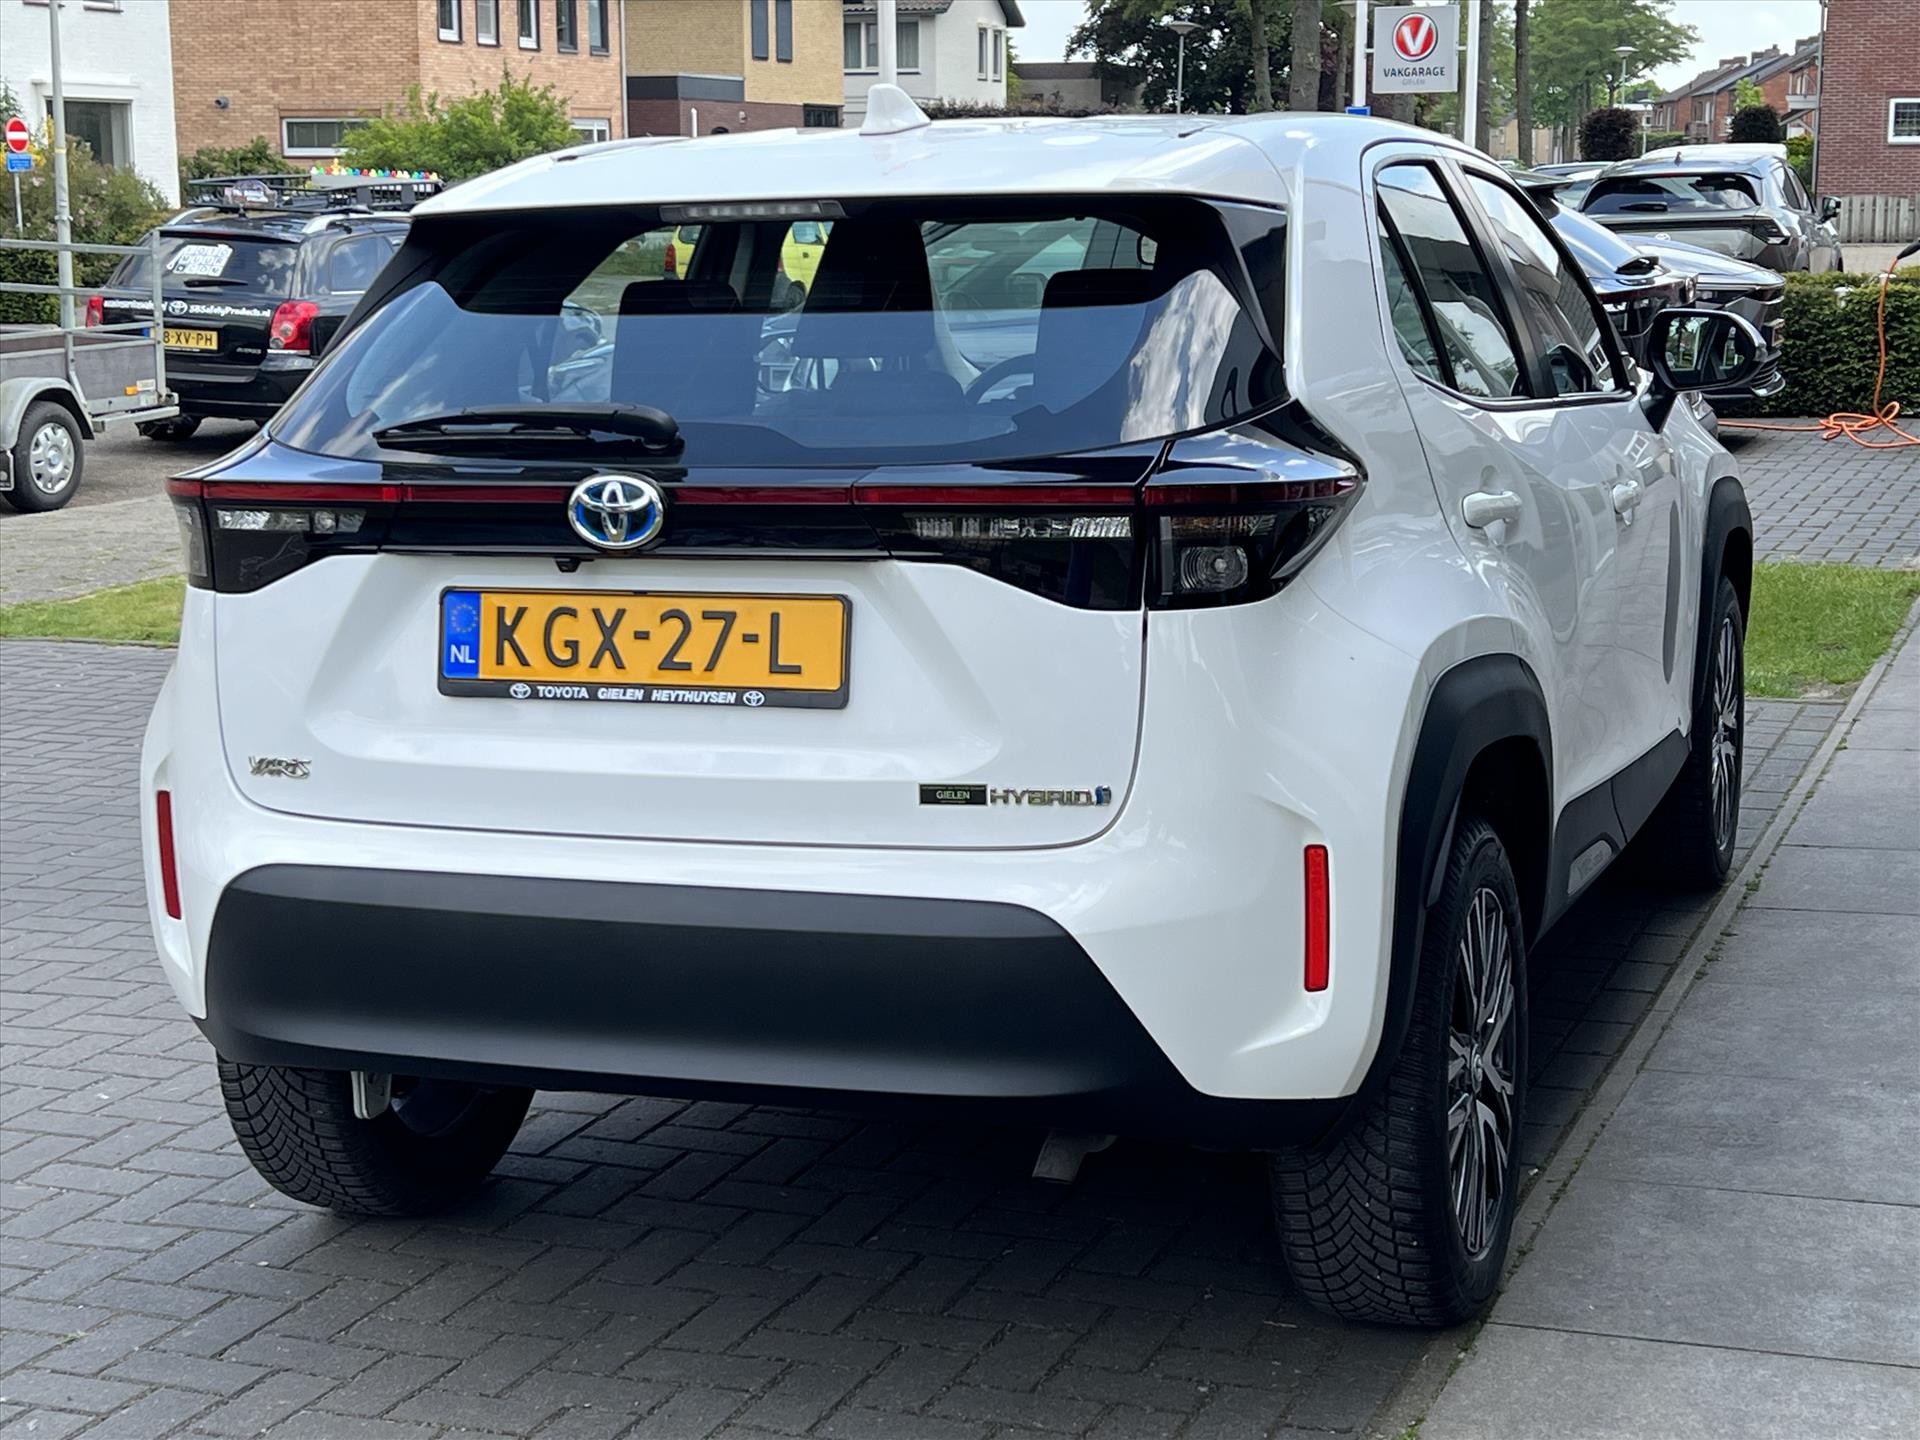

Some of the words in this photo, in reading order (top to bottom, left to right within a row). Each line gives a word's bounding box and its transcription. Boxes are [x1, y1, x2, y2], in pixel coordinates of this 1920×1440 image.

[1383, 66, 1446, 77] VAKGARAGE
[162, 331, 213, 347] 8-XV-PH
[495, 606, 803, 676] KGX-27-L
[450, 644, 476, 664] NL
[537, 684, 589, 700] TOYOTA
[597, 687, 645, 702] GIELEN
[650, 690, 737, 705] HEYTHUYSEN
[935, 790, 971, 800] GIELEN
[989, 788, 1094, 806] HYBRID
